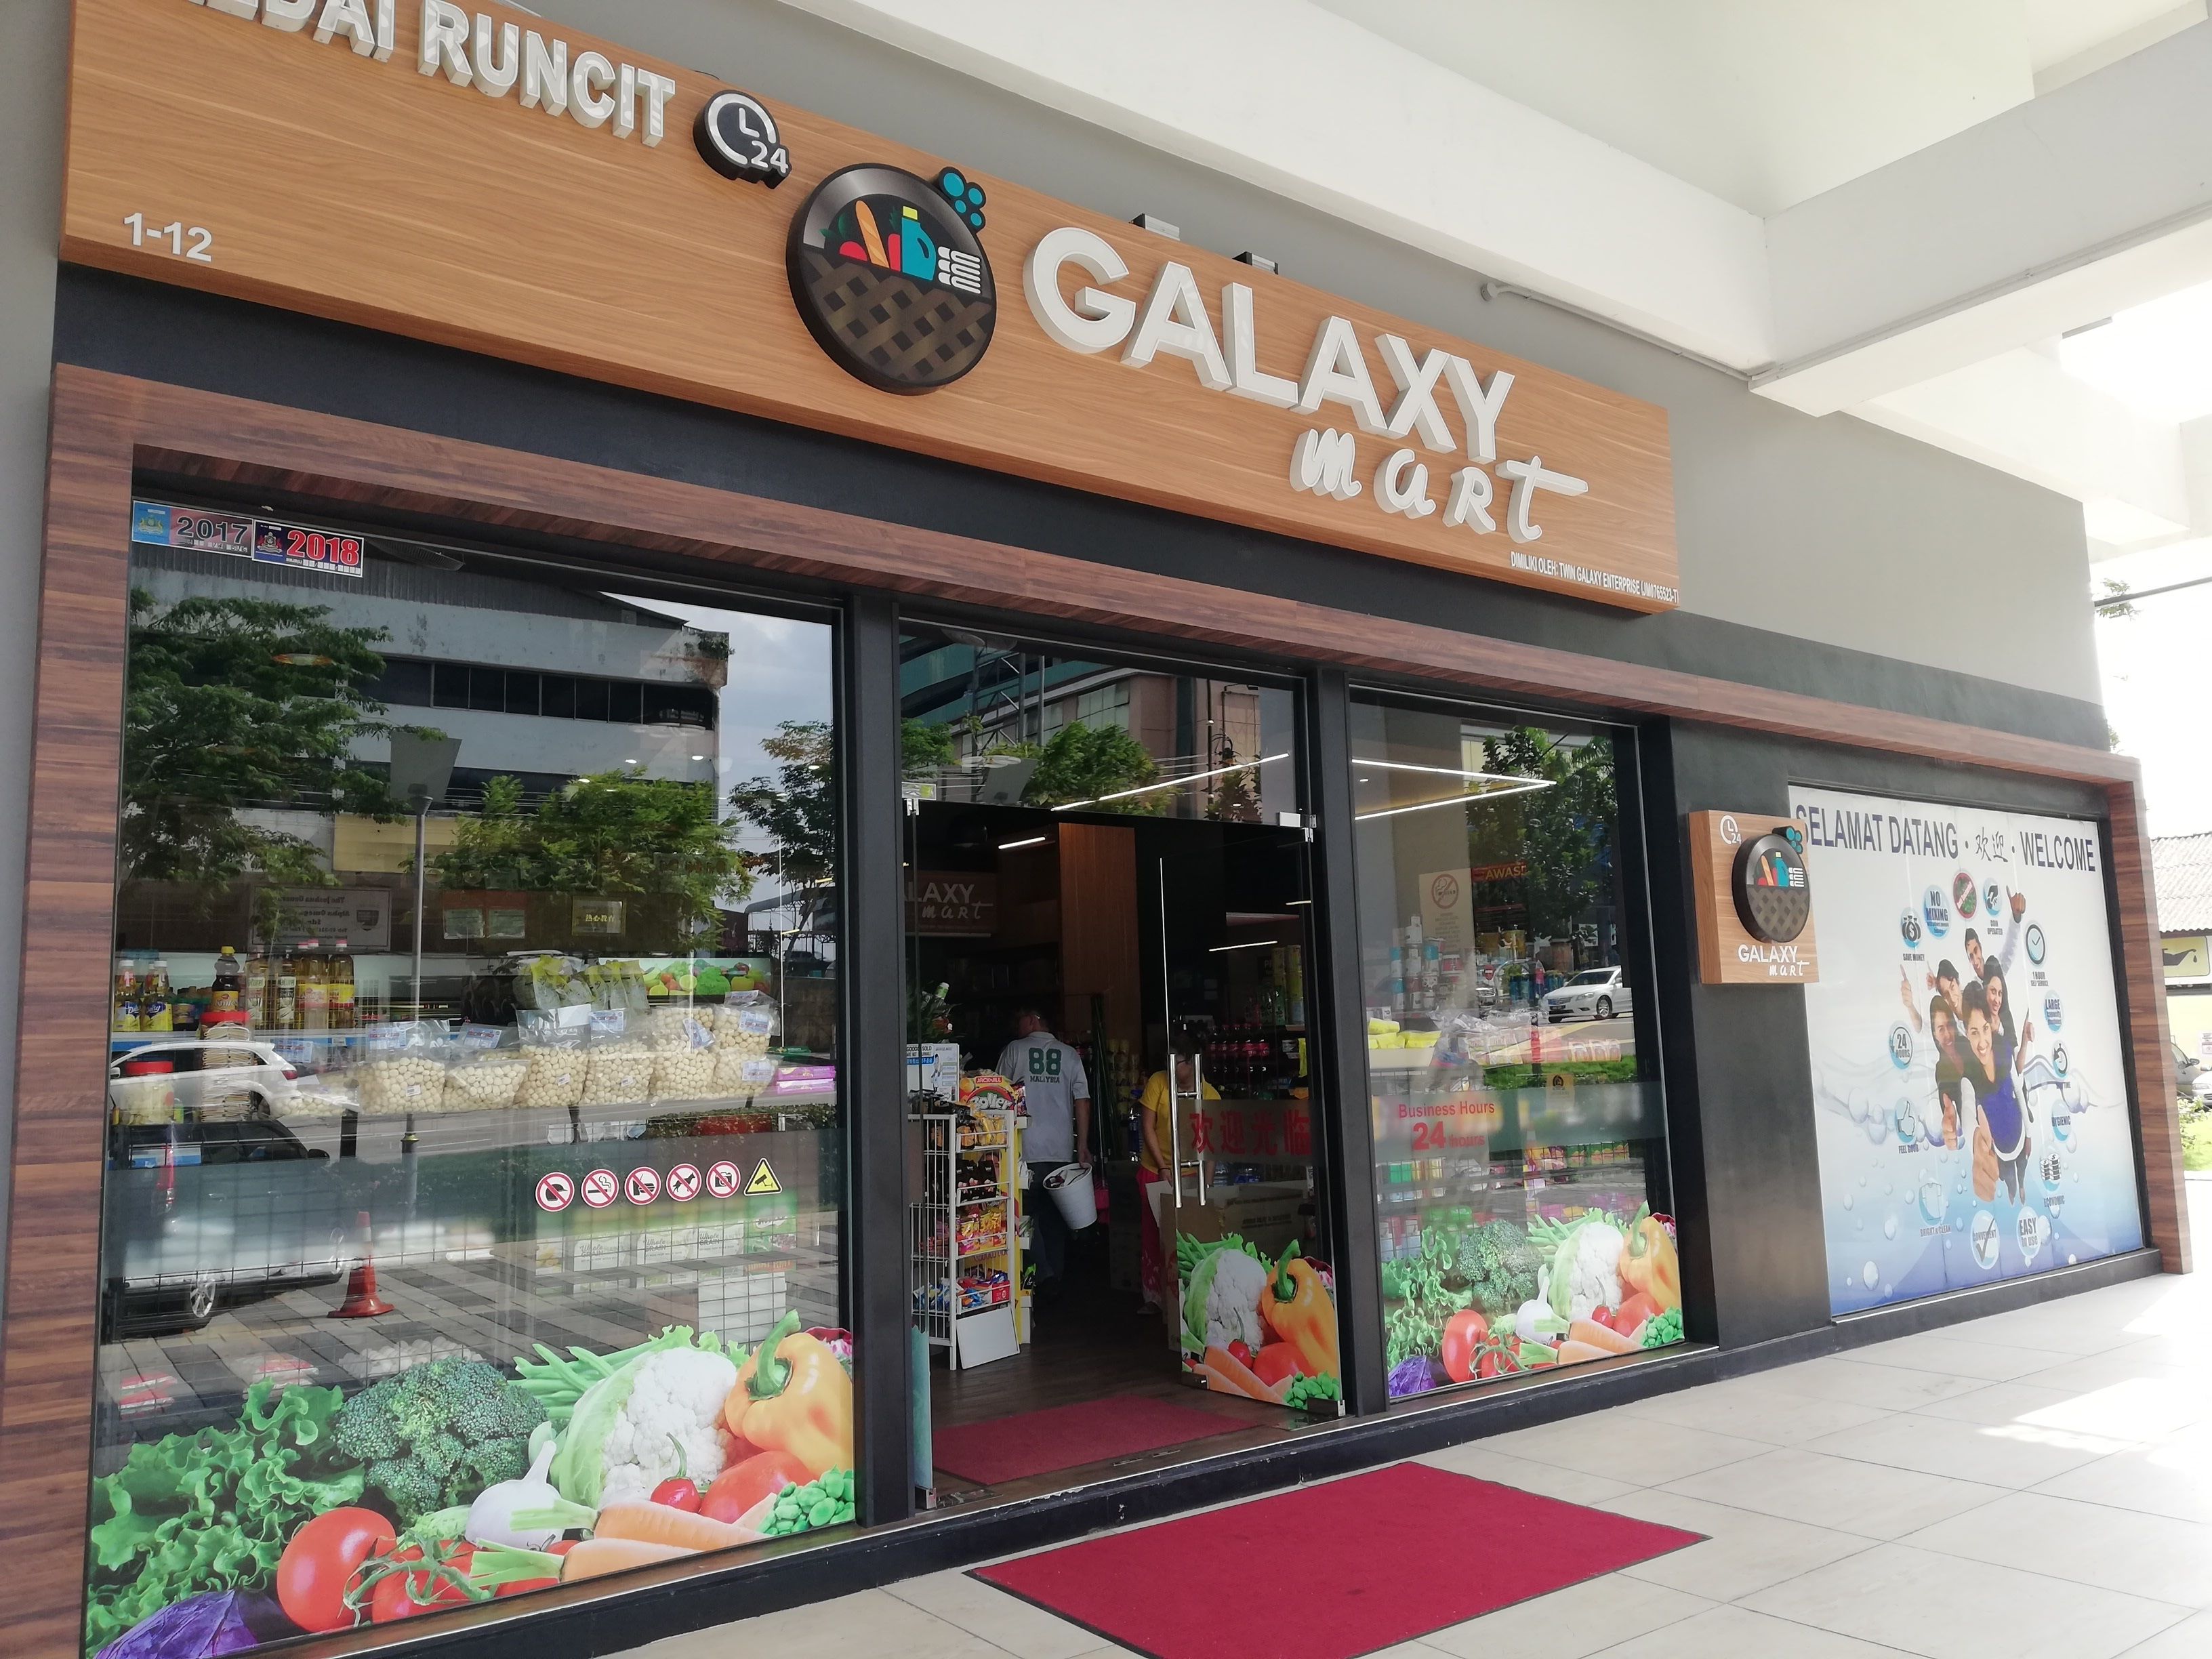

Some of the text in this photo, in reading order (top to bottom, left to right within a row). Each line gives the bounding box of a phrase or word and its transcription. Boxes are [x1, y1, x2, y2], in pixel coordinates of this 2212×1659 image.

[417, 0, 675, 148] RUNCIT
[750, 140, 789, 173] 24
[123, 213, 213, 263] 1-12
[1023, 226, 1515, 464] GALAXY
[176, 516, 248, 545] 2017
[286, 530, 360, 566] 2018
[1511, 551, 1537, 571] DIMILIKI
[1538, 558, 1558, 576] OLEH:
[1559, 562, 1576, 580] TWIN
[1576, 567, 1602, 586] GALAXY
[1603, 573, 1640, 594] ENTERPRISE
[1732, 833, 1741, 844] 24
[1796, 804, 1959, 859] SELAMAT DATANG
[1975, 826, 2009, 863] 欢迎
[2020, 831, 2096, 872] WELCOME
[1930, 891, 1941, 907] NO
[1926, 907, 1948, 922] MIXING
[1738, 944, 1797, 963] GALAXY
[2045, 999, 2061, 1010] LARGE
[1896, 1050, 1910, 1059] HOURS
[1897, 1034, 1907, 1048] 24
[1028, 1047, 1061, 1076] 88
[1399, 1101, 1495, 1118] Business Hours
[2052, 1115, 2070, 1127] HYGIENIC
[1189, 1108, 1313, 1155] 欢迎光临
[1412, 1120, 1485, 1150] 24 hours
[1899, 1145, 1907, 1154] FEEL
[2020, 1216, 2036, 1236] EASY
[2021, 1235, 2038, 1247] to use
